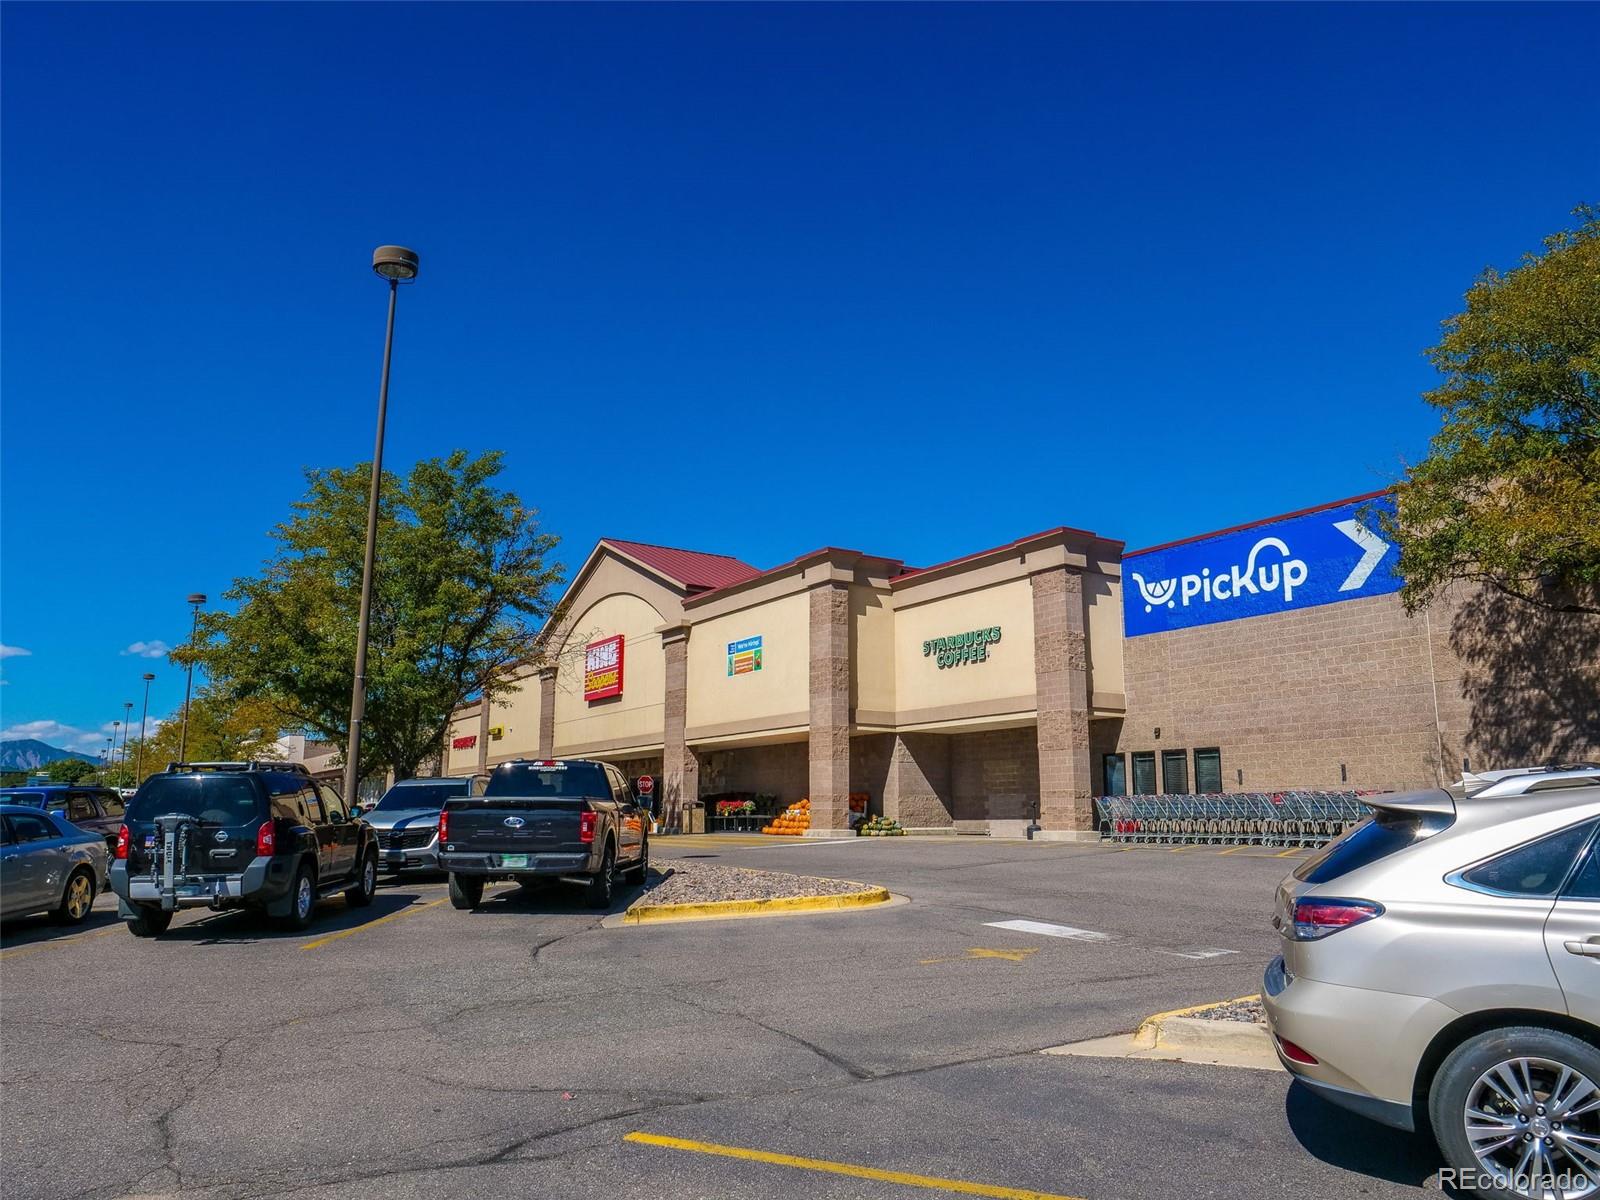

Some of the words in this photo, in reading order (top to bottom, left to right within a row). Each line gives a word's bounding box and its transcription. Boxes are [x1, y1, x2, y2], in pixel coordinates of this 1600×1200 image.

[923, 626, 1002, 657] STARBUCKS
[937, 645, 986, 669] COFFEE
[640, 780, 652, 788] STOP
[165, 840, 174, 865] THULE
